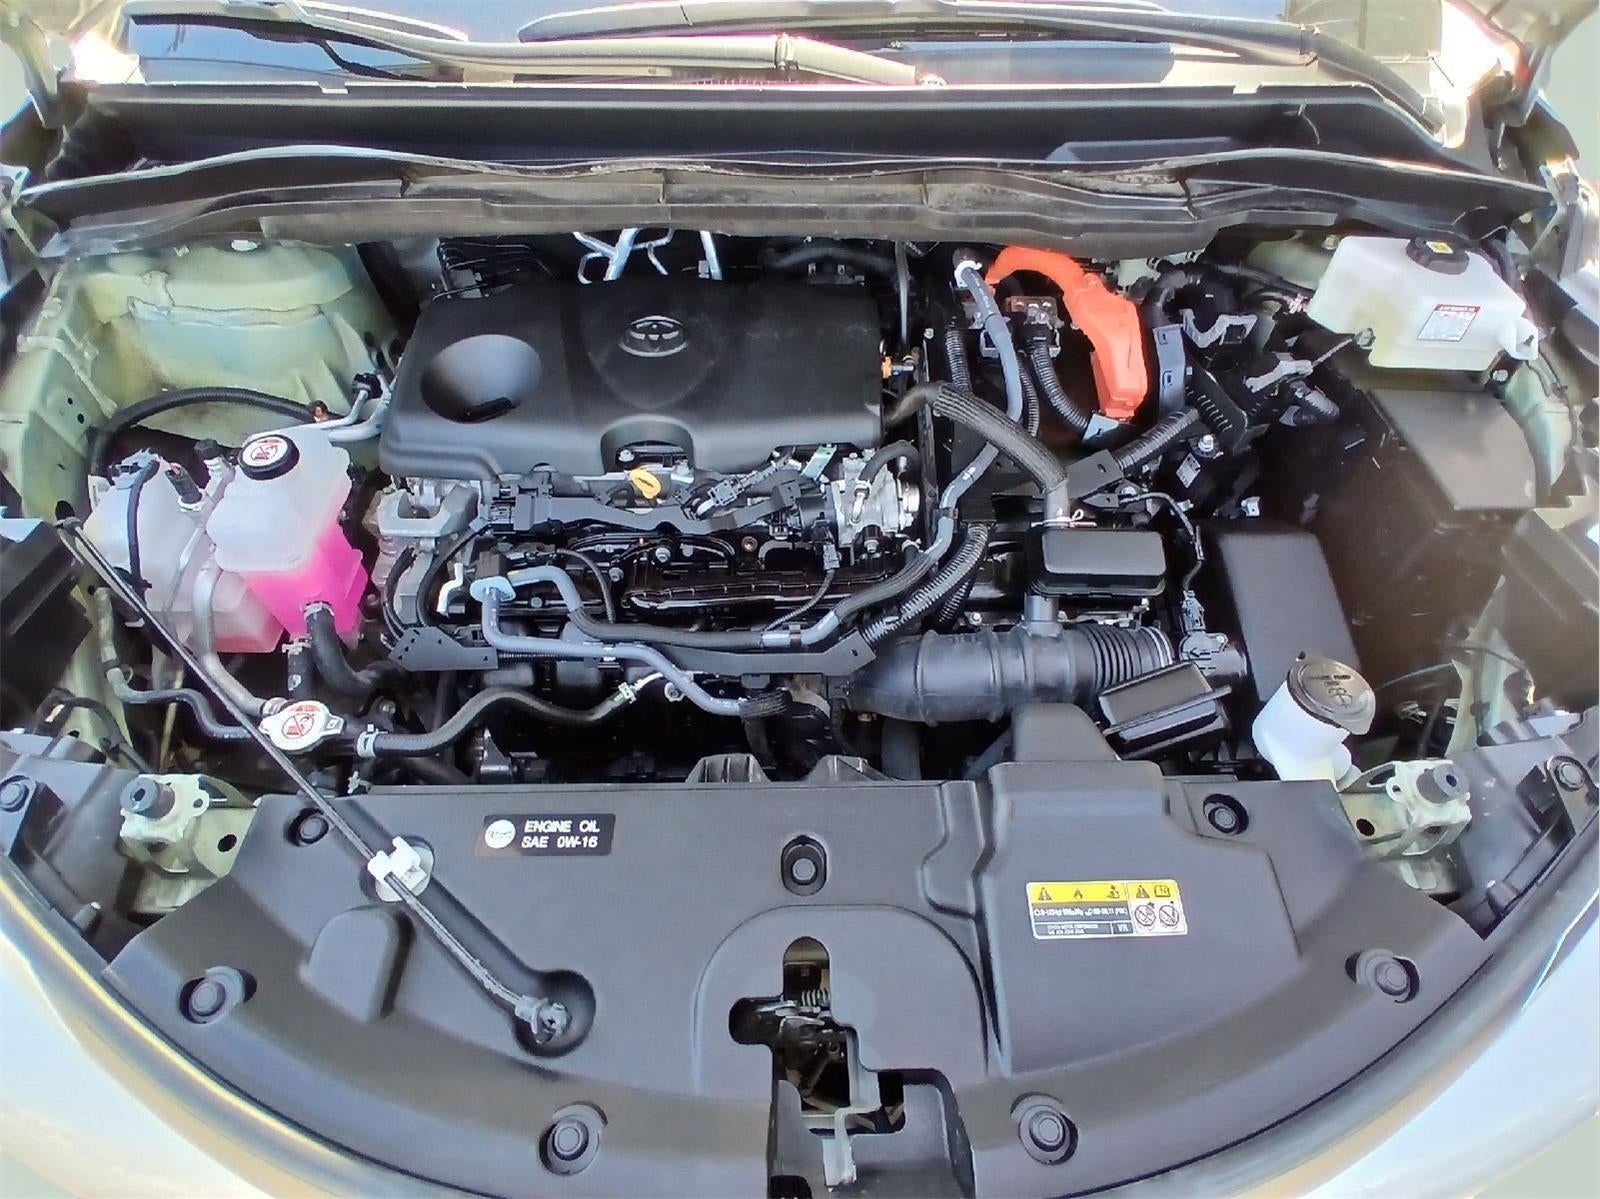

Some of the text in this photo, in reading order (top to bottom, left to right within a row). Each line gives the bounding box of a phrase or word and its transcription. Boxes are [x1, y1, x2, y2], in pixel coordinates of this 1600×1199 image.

[524, 820, 600, 833] ENGINE OIL
[521, 836, 598, 848] SAE 0W-16
